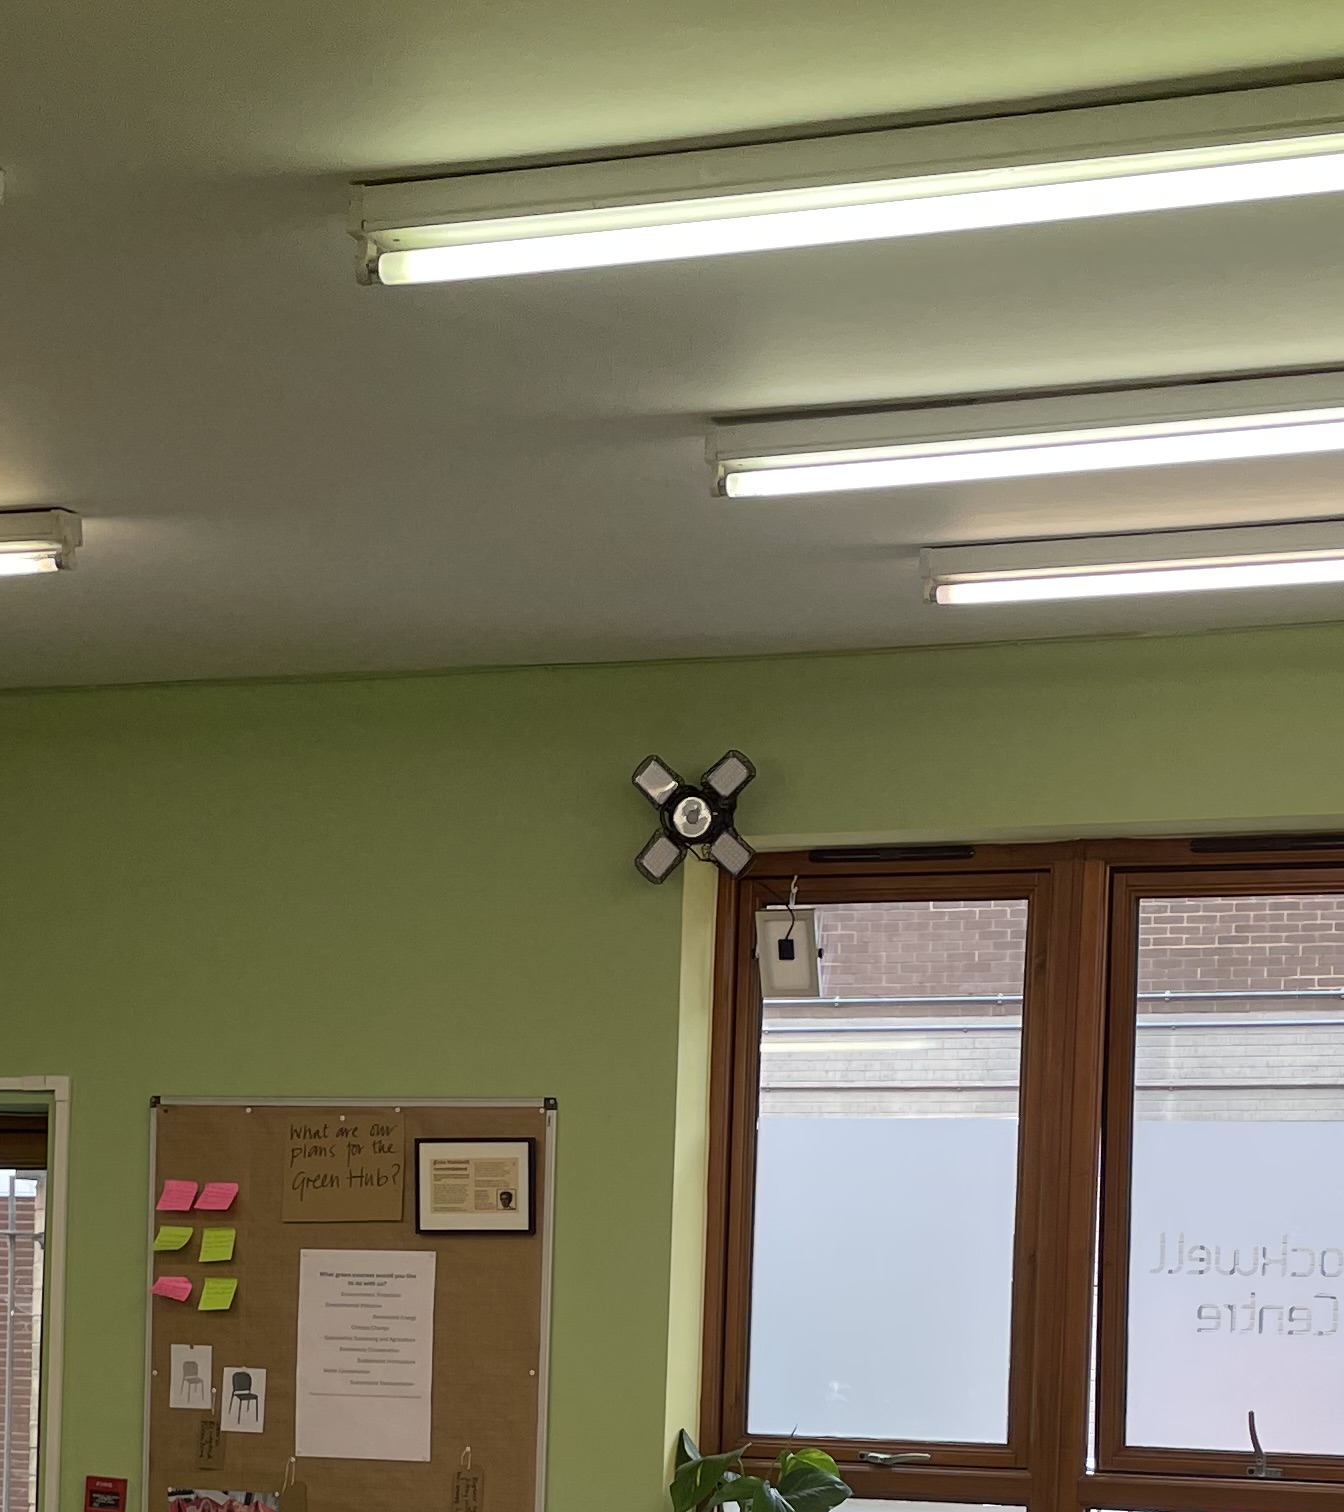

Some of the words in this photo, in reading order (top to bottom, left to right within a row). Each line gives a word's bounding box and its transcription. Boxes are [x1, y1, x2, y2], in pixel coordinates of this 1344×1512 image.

[290, 1123, 328, 1140] What
[335, 1126, 358, 1138] are
[370, 1123, 398, 1137] our
[290, 1144, 336, 1168] plans
[346, 1141, 365, 1167] for
[372, 1140, 396, 1154] the
[292, 1171, 340, 1202] Green
[347, 1163, 401, 1189] Hub?
